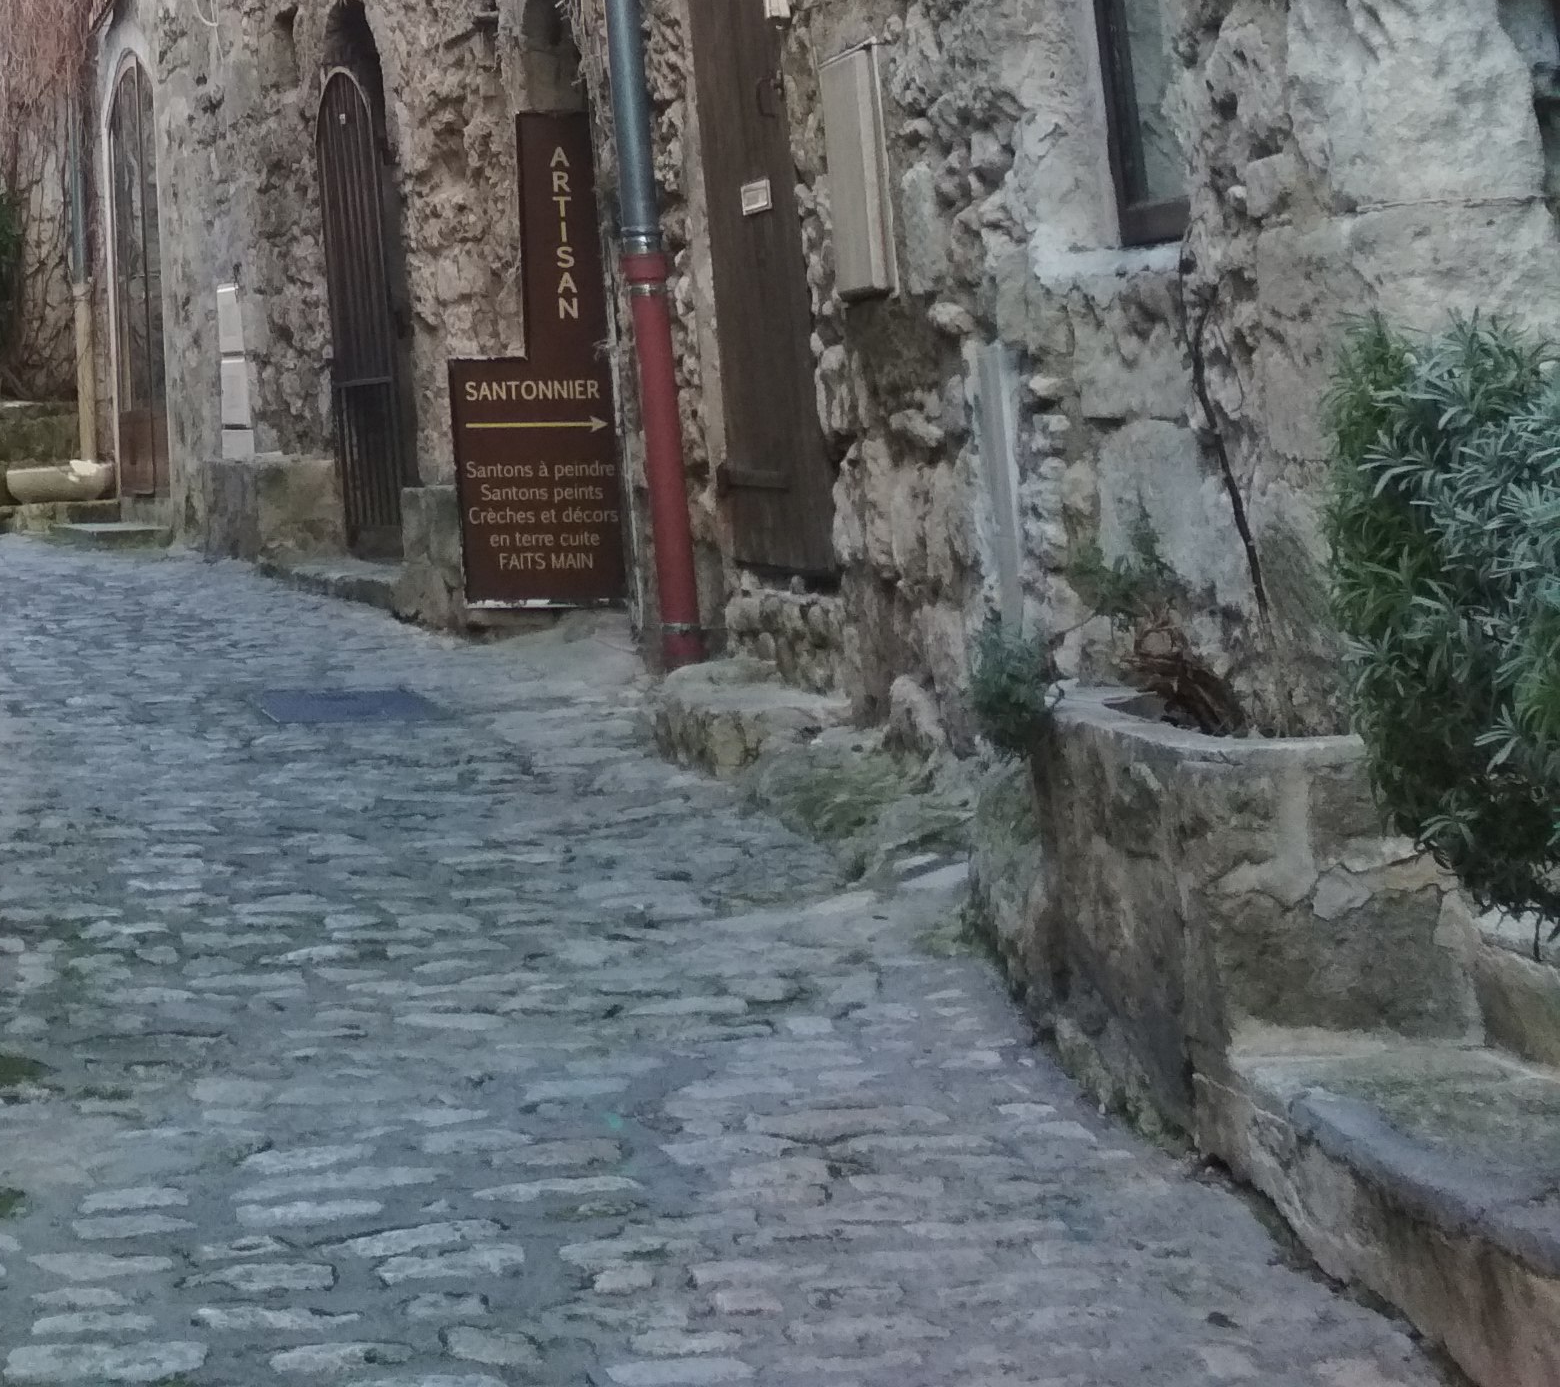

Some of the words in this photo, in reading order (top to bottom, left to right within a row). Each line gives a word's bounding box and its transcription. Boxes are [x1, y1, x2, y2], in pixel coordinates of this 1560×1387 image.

[550, 146, 579, 319] ARTISAN
[465, 380, 600, 401] SANTONNIER
[466, 461, 534, 479] Santons
[539, 460, 549, 477] à
[554, 460, 615, 481] peindre
[481, 484, 548, 501] Santons
[553, 483, 604, 504] peints
[469, 507, 536, 525] Crèches
[541, 508, 556, 524] et
[562, 506, 619, 523] décors
[490, 533, 510, 547] en
[515, 531, 555, 547] terre
[560, 530, 601, 547] cuite
[499, 553, 546, 570] FAITS
[551, 553, 594, 569] MAIN
